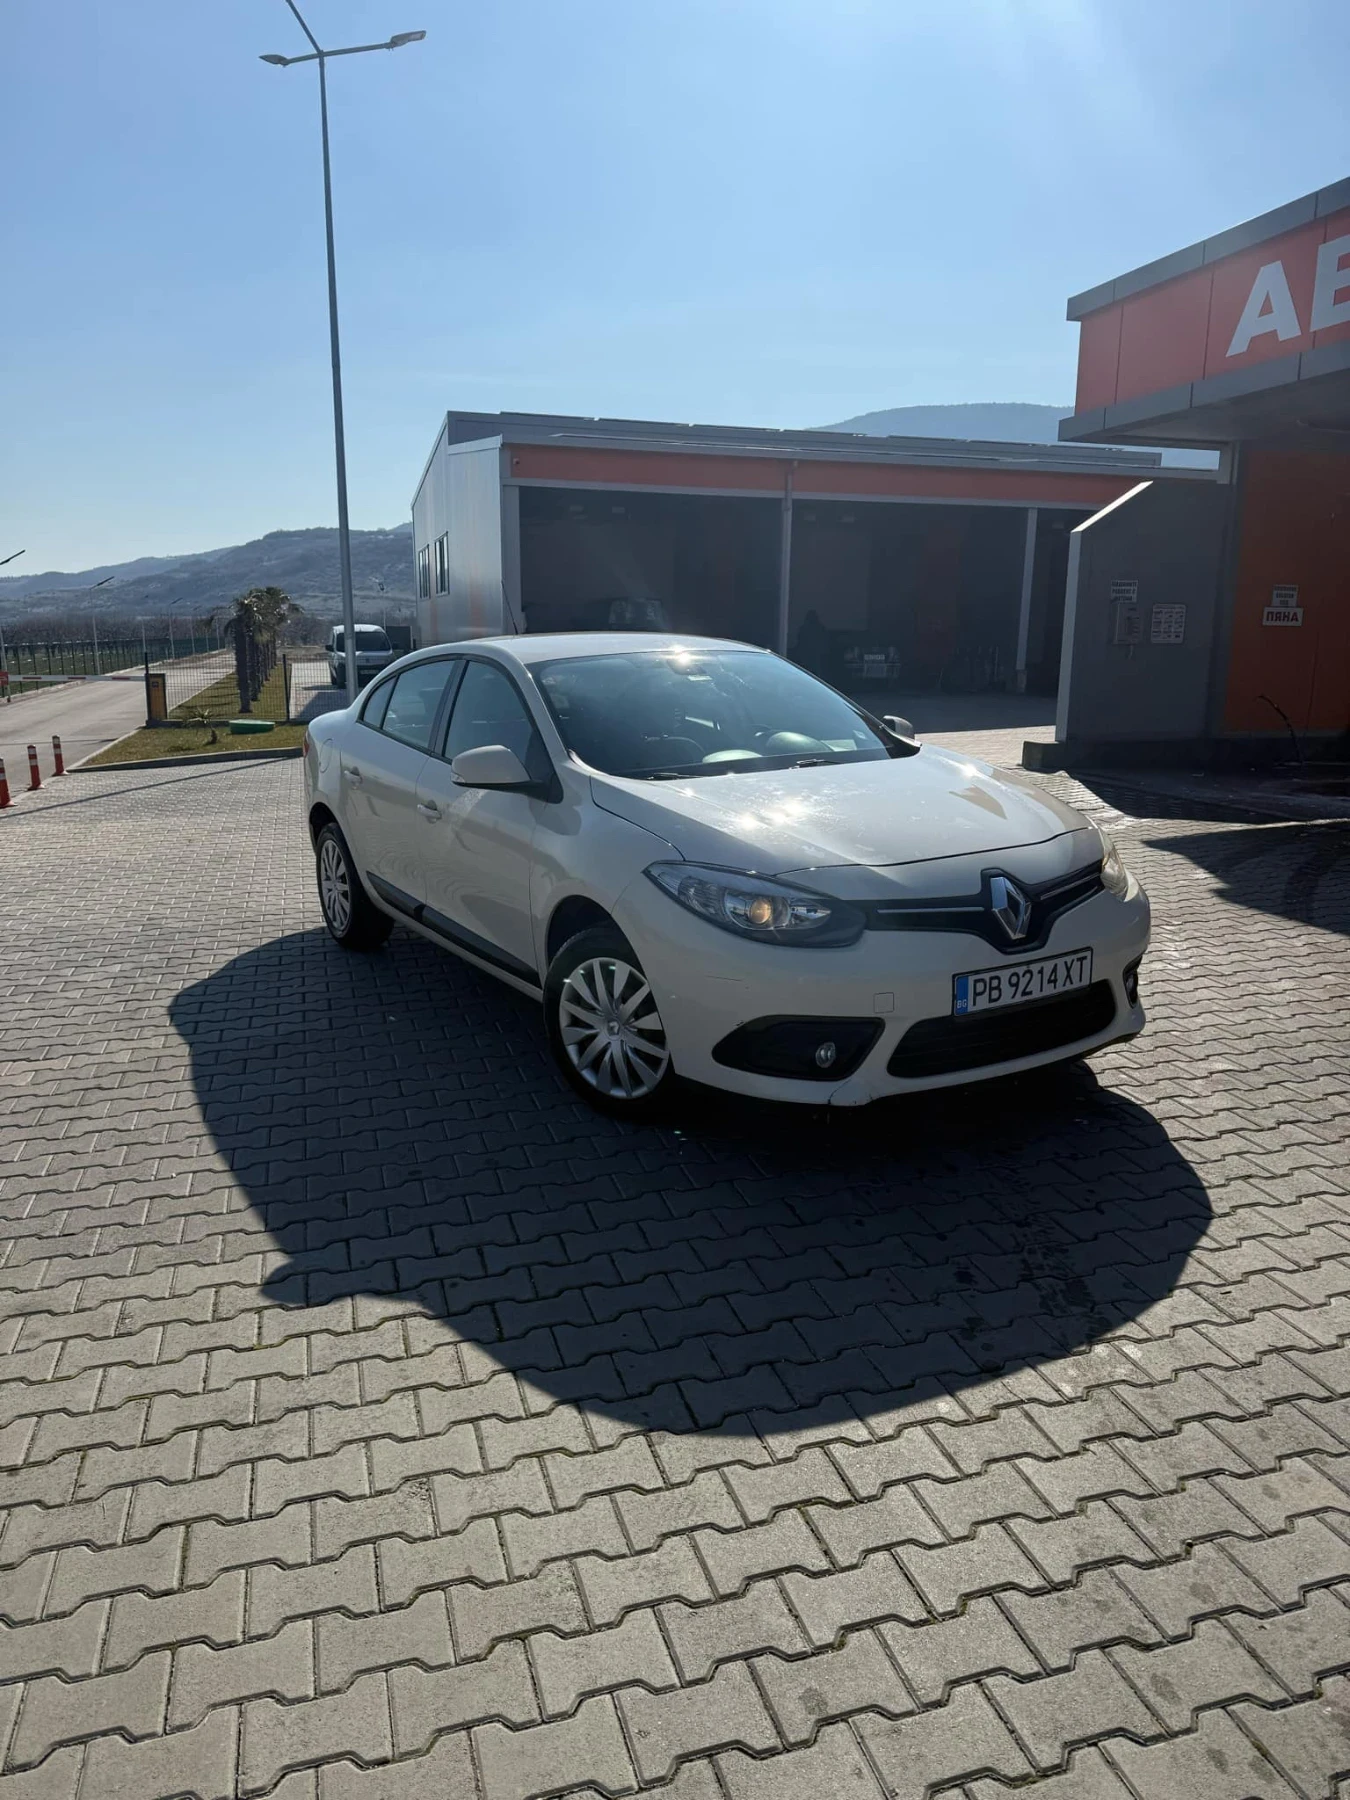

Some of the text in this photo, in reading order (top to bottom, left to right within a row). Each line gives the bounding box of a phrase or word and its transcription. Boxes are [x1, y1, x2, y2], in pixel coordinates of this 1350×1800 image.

[1266, 611, 1299, 622] ПЯНА
[972, 956, 1088, 1007] PB 9214 XT
